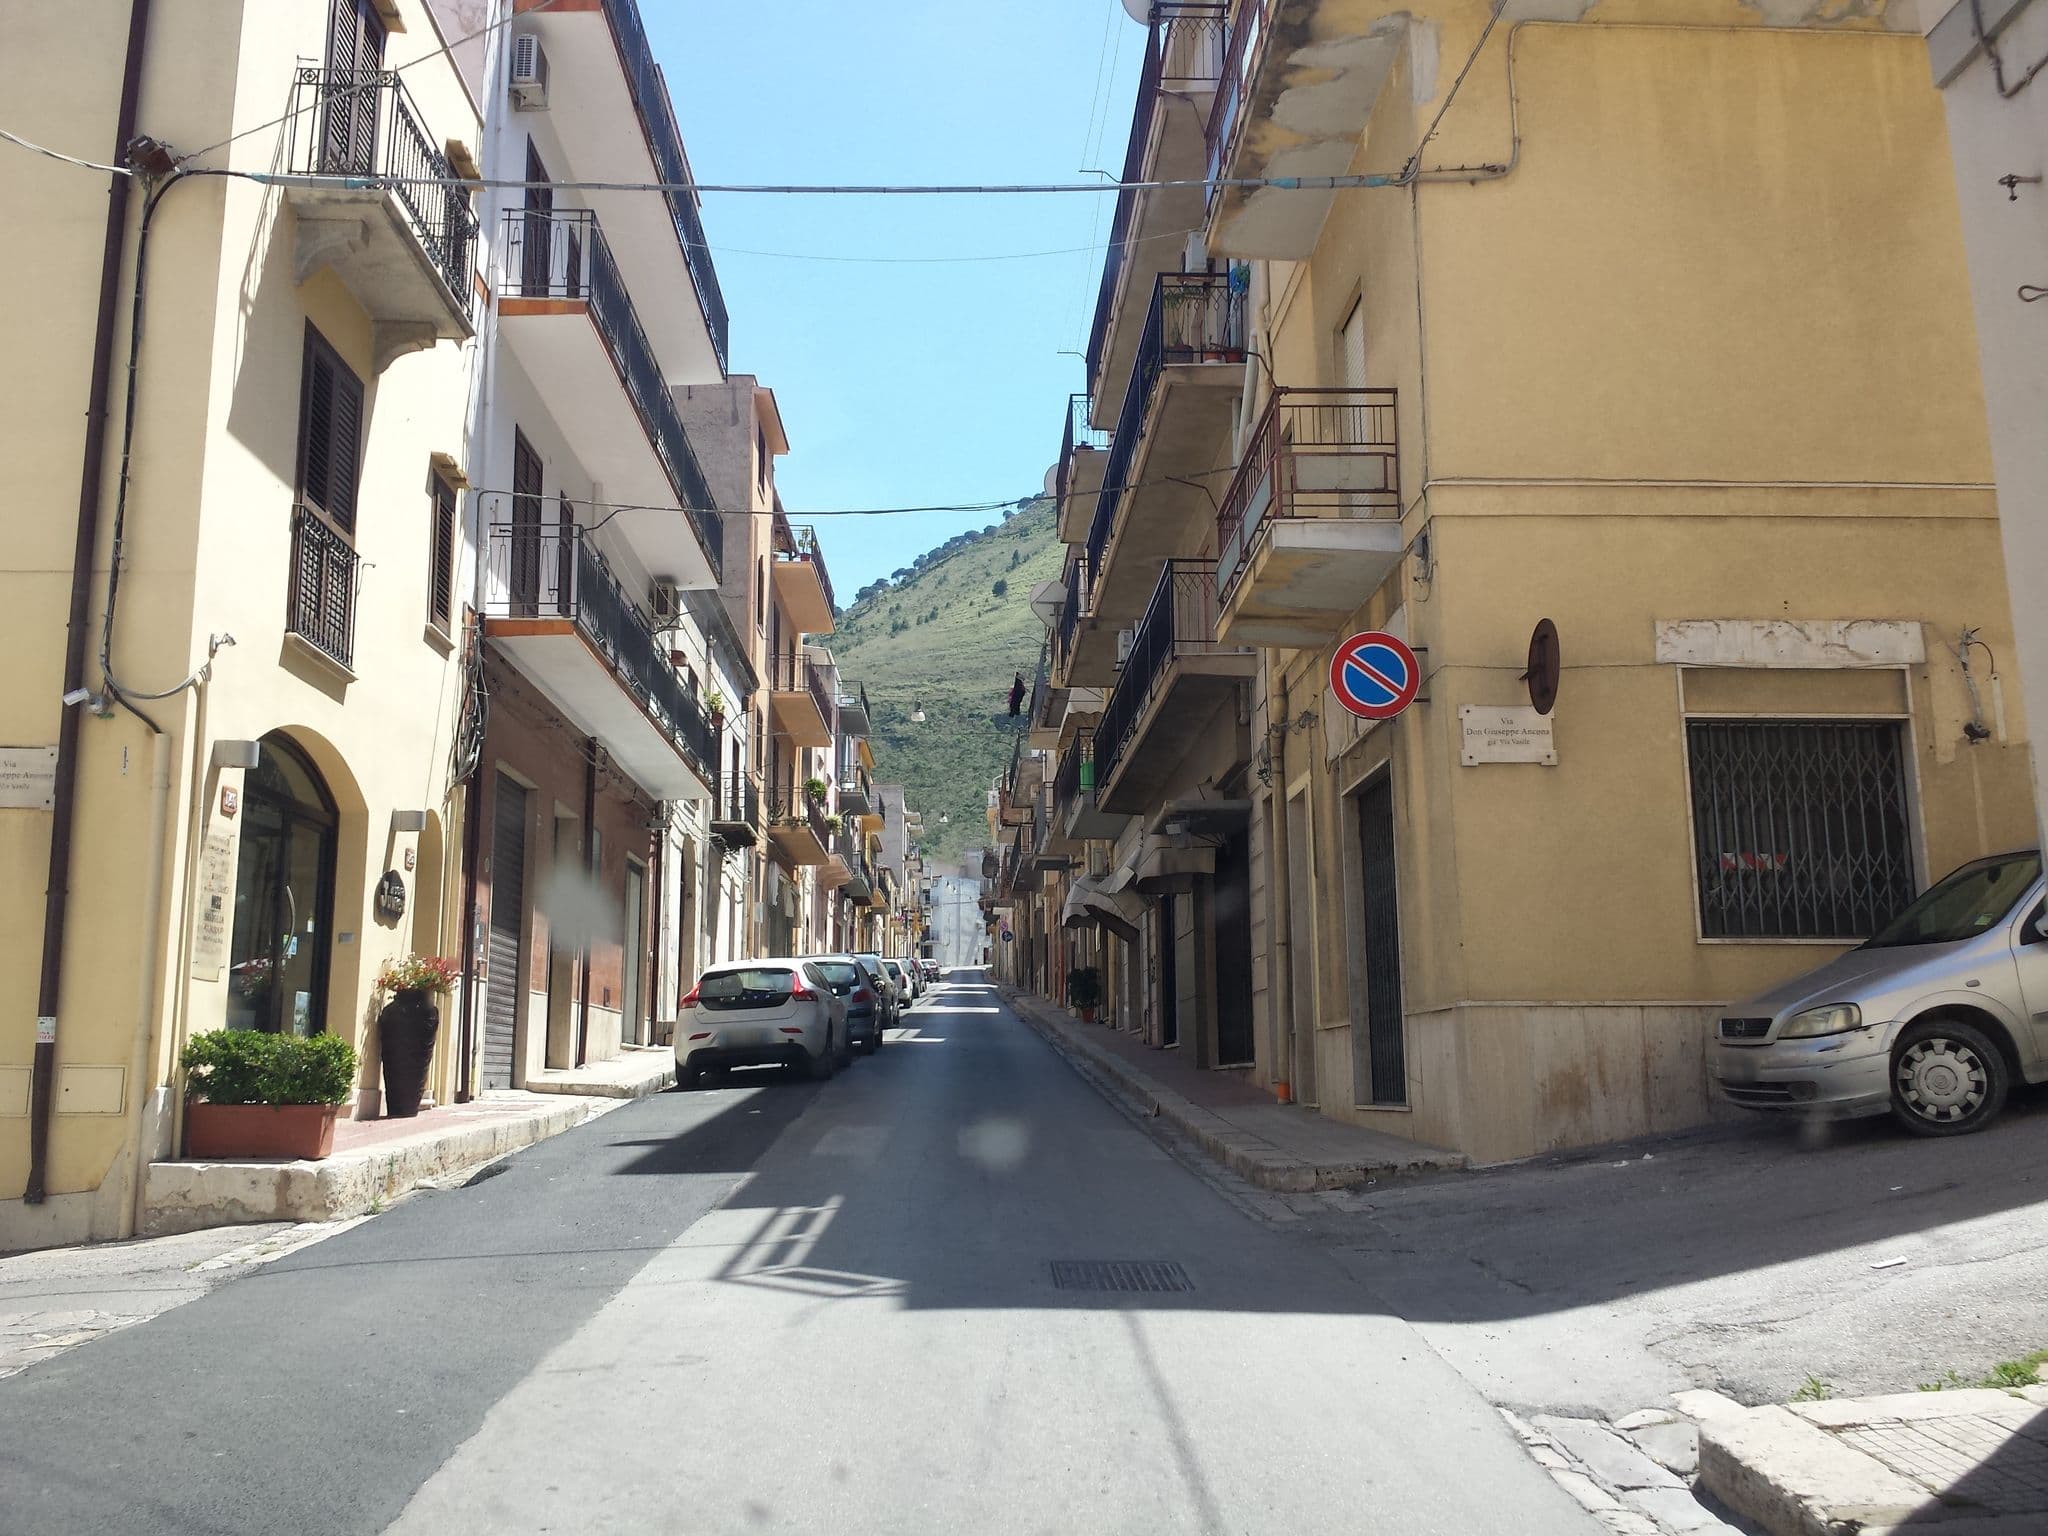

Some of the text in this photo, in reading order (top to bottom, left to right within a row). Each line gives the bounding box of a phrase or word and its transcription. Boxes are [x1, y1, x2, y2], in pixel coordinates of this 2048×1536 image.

[1501, 717, 1514, 725] Via
[1466, 728, 1483, 736] Don
[1484, 728, 1519, 737] Giuseppe
